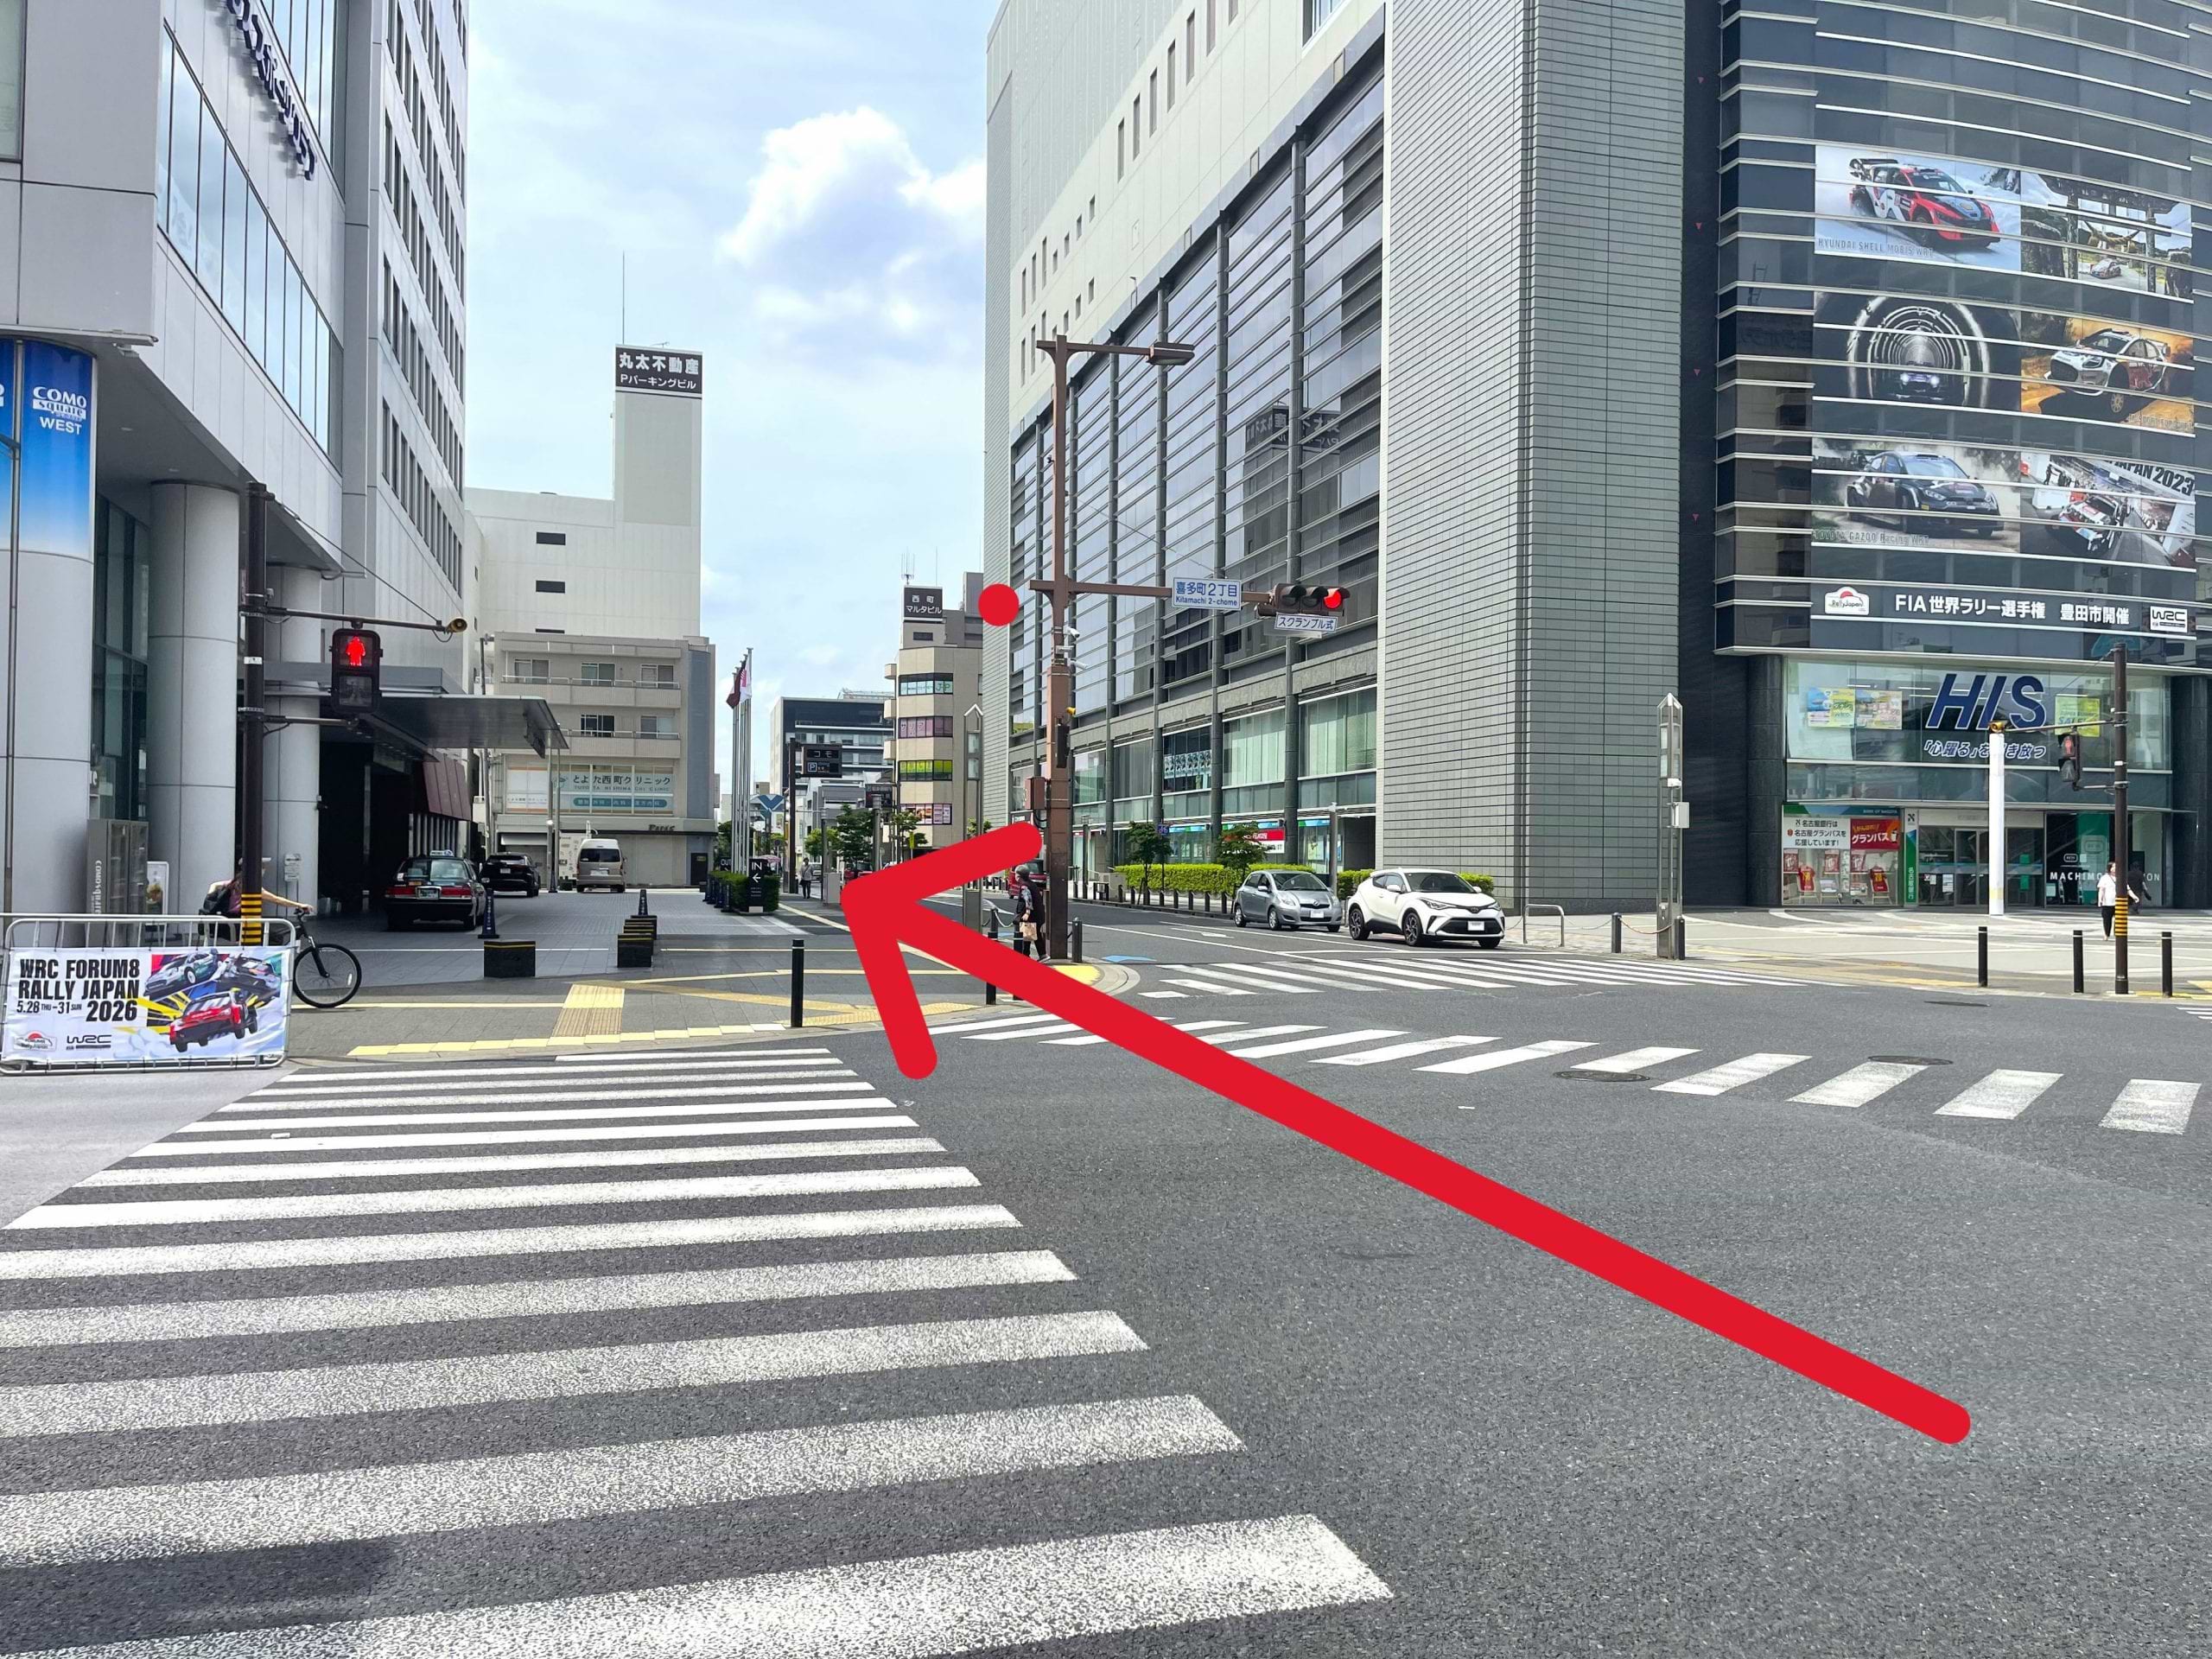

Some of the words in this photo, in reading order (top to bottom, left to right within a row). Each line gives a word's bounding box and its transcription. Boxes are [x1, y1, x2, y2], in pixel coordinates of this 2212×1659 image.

[1818, 238, 1855, 250] HYUNDAI
[1859, 241, 1884, 252] SHELL
[619, 352, 699, 375] 丸太不動産
[33, 386, 87, 409] COMO
[40, 416, 82, 435] WEST
[2152, 467, 2195, 496] 2023
[1176, 582, 1237, 597] 喜多町2丁目
[906, 605, 942, 614] マルタビル
[1176, 595, 1207, 605] Kitamachi
[1278, 616, 1334, 630] スクランブル式
[2060, 603, 2129, 625] 豊田市開催
[2152, 608, 2185, 622] WRC
[1925, 673, 2047, 731] HIS
[1923, 739, 2047, 759] 「心躍る」をき放つ
[573, 774, 671, 785] とよた西町クリニック
[752, 861, 762, 871] IN
[20, 959, 59, 979] WRC
[66, 958, 140, 979] FORUM8
[18, 980, 75, 1001] RALLY
[81, 979, 140, 1000] JAPAN
[16, 1001, 40, 1014] 5.28
[86, 1000, 138, 1022] 2026
[67, 1034, 112, 1044] WRC
